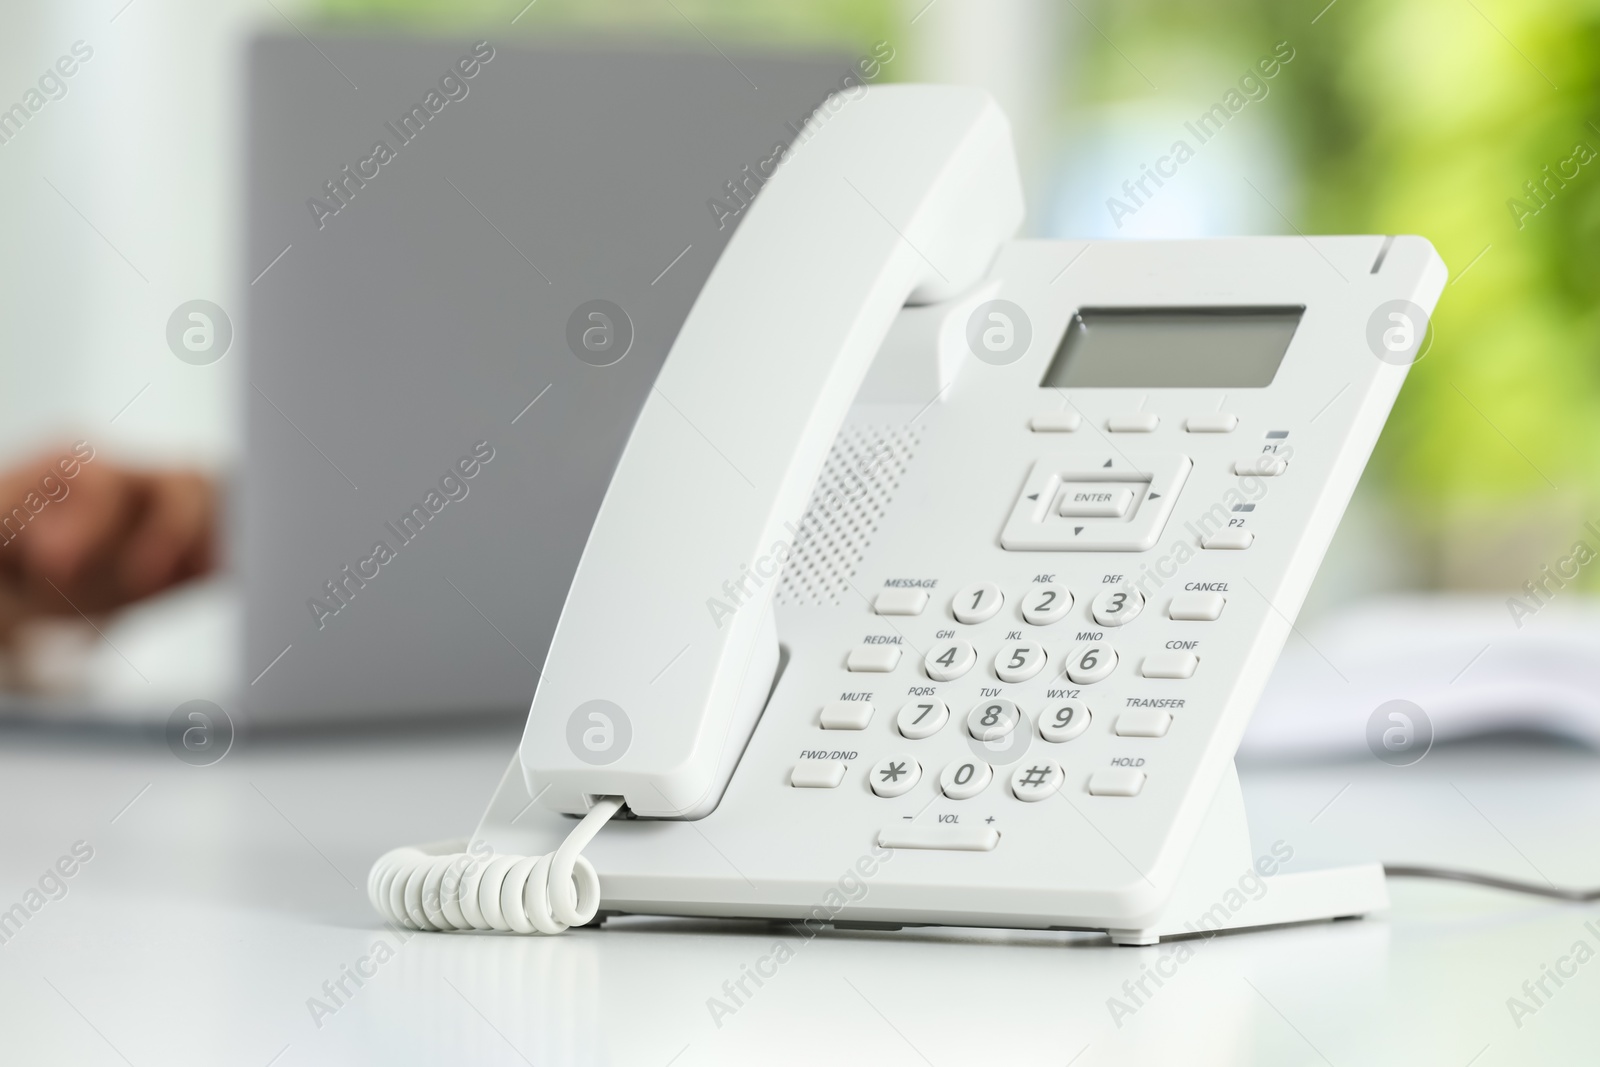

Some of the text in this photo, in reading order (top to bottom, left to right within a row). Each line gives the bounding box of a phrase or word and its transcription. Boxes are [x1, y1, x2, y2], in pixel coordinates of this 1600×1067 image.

[1262, 444, 1278, 454] P1
[1073, 493, 1113, 502] ENTER
[1228, 518, 1246, 528] P2
[884, 578, 937, 589] MESSAGE
[1032, 574, 1056, 583] ABC
[1102, 574, 1123, 584] DEF
[1184, 582, 1229, 592] CANCEL
[971, 589, 984, 610] 1
[1034, 590, 1057, 612] 2
[1105, 592, 1128, 614] 3
[935, 629, 956, 639] GHI
[1004, 631, 1022, 640] JKL
[1075, 632, 1104, 641] MNO
[863, 635, 903, 645] REDIAL
[1165, 640, 1199, 650] CONF
[935, 646, 958, 668] 4
[1007, 648, 1030, 669] 5
[1079, 648, 1100, 671] 6
[839, 692, 873, 702] MUTE
[907, 686, 937, 697] PQRS
[979, 687, 1002, 698] TUV
[1046, 689, 1081, 699] WXYZ
[1126, 697, 1186, 709] TRANSFER
[911, 704, 934, 725] 7
[980, 704, 1003, 727] 8
[1051, 706, 1074, 729] 9
[799, 750, 859, 760] FWD/DND
[1110, 757, 1145, 768] HOLD
[953, 763, 975, 786] 0
[1018, 765, 1053, 788] #
[938, 814, 959, 824] VOL
